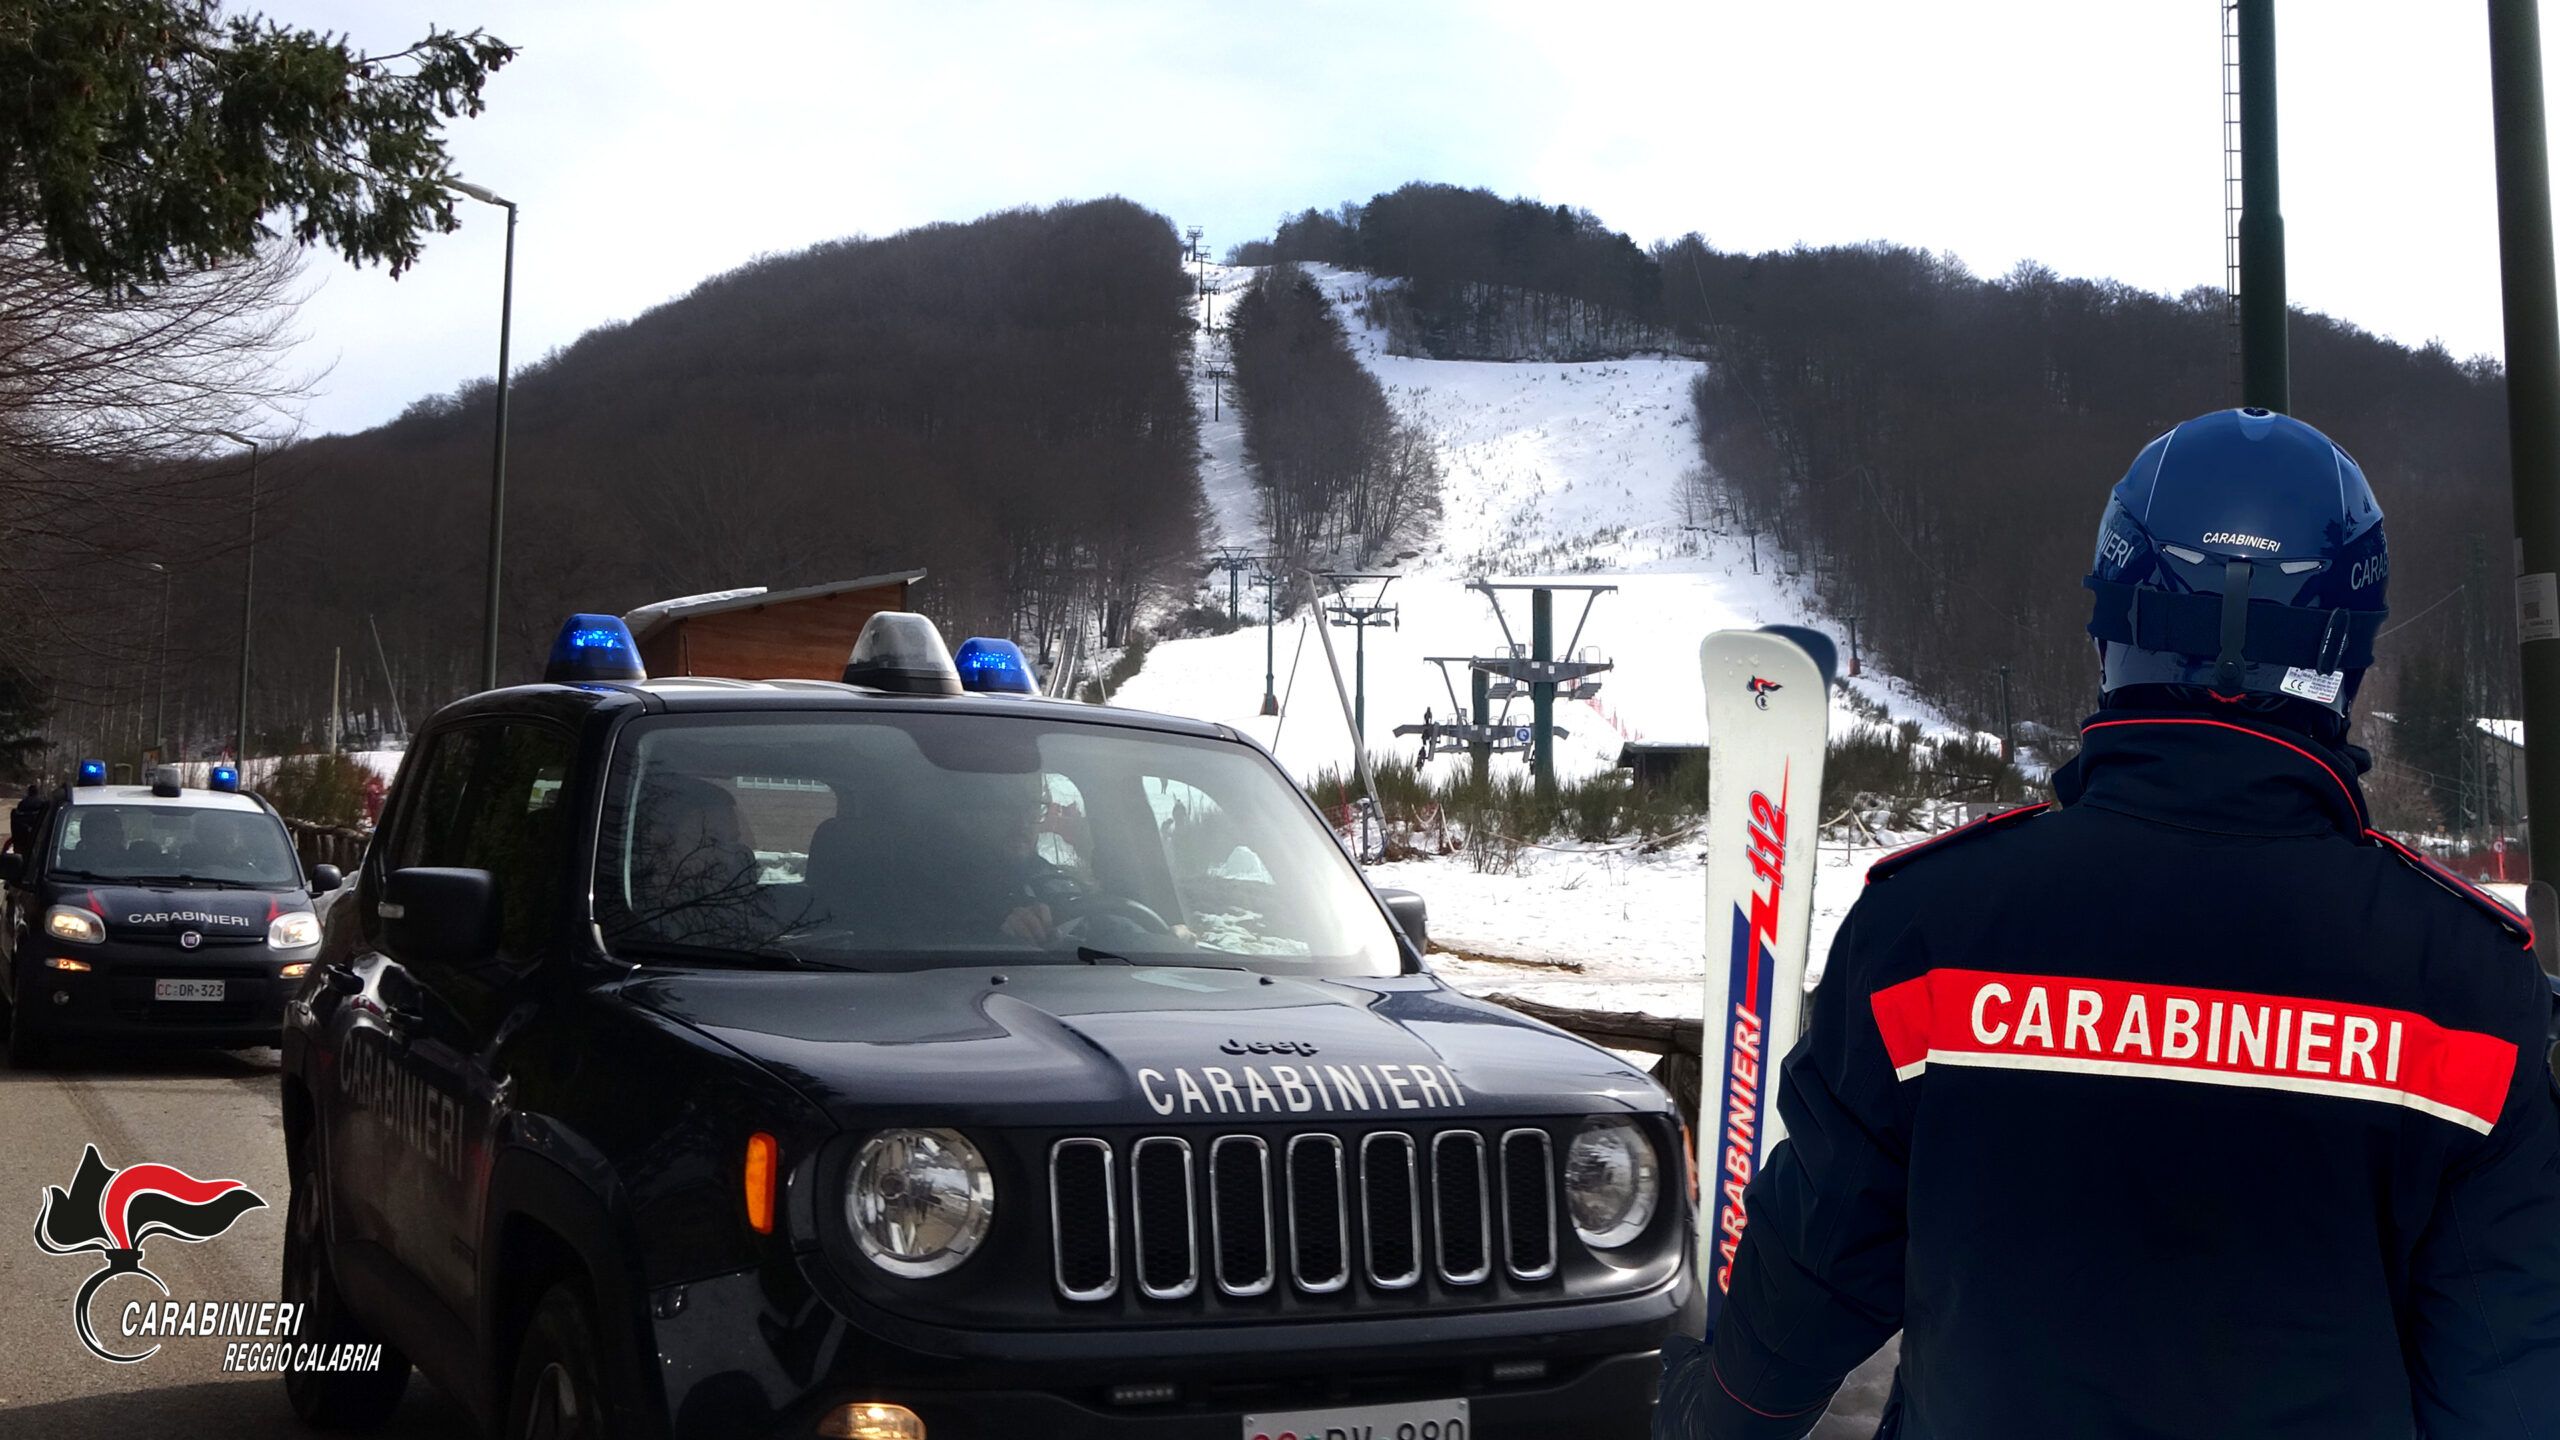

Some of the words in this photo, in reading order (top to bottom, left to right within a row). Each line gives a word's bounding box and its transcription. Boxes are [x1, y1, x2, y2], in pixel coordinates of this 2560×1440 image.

[2202, 532, 2281, 552] CARABINIERI
[1745, 790, 1788, 890] 112
[128, 911, 249, 927] CARABINIERI
[1970, 982, 2403, 1082] CARABINIERI
[340, 1026, 464, 1182] CARABINIERI
[1137, 1064, 1466, 1116] CARABINIERI
